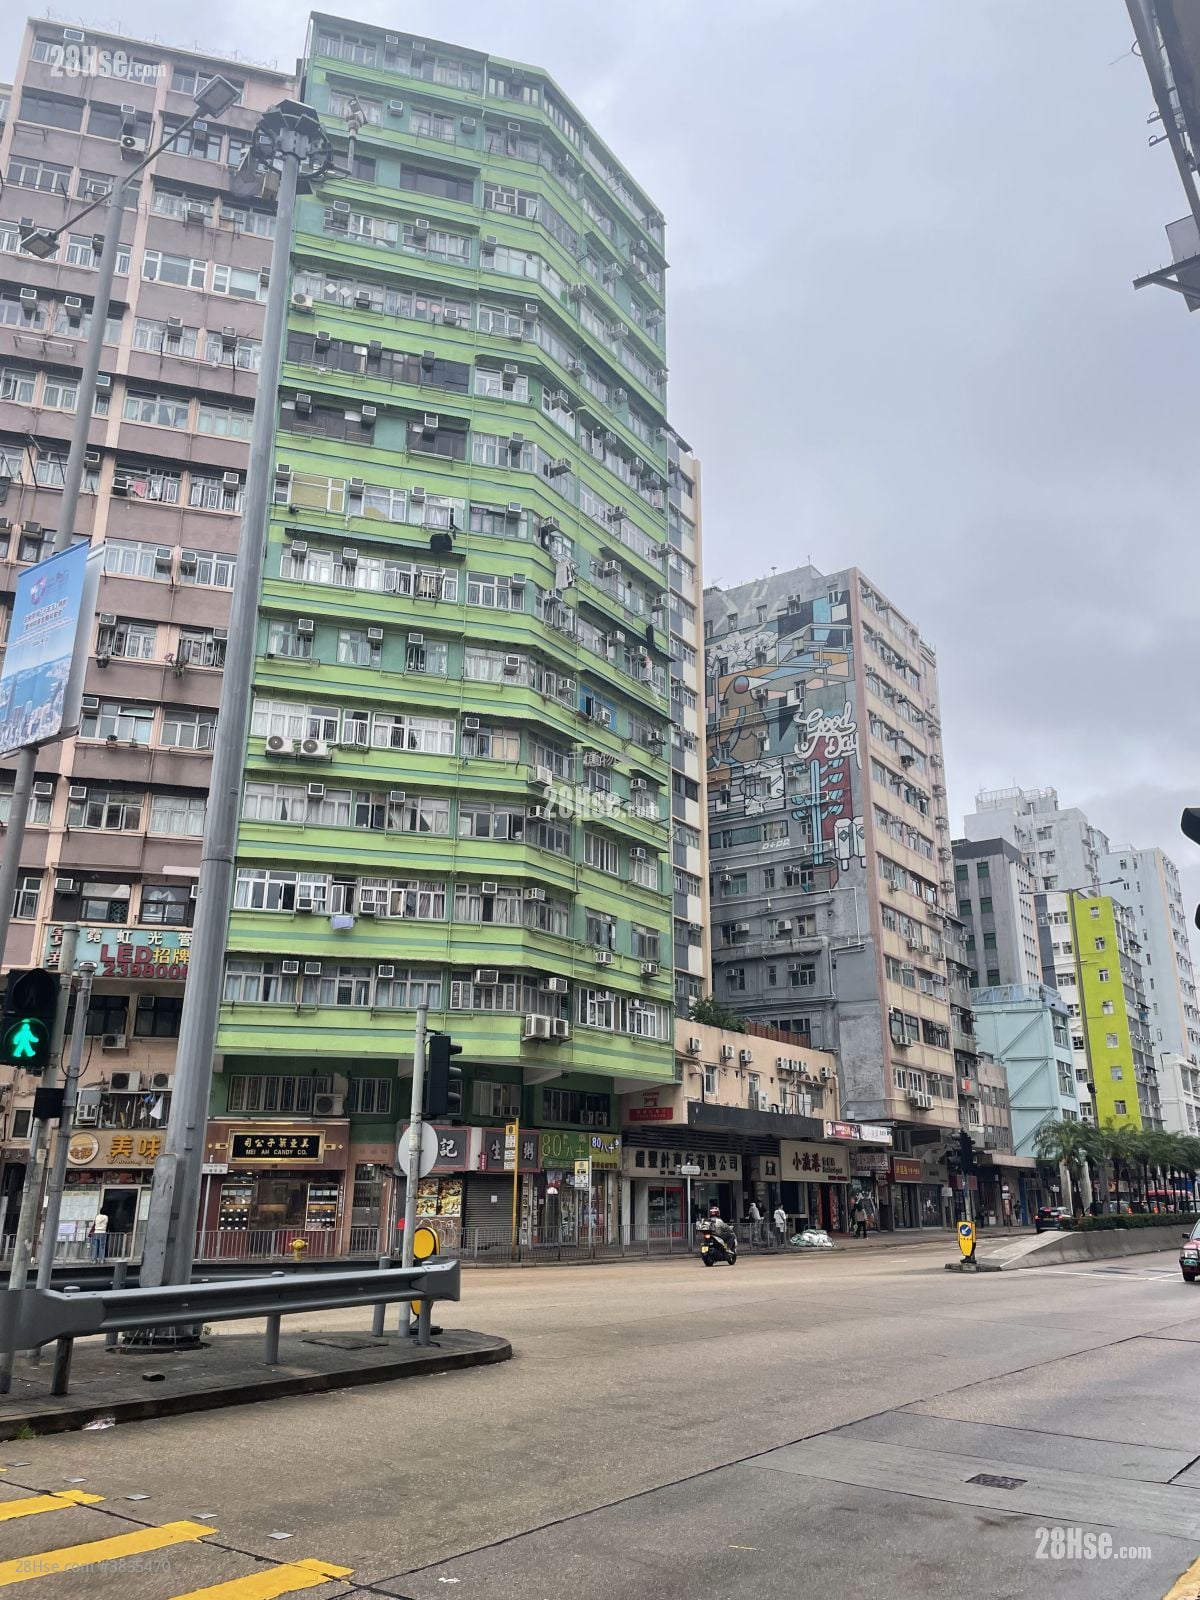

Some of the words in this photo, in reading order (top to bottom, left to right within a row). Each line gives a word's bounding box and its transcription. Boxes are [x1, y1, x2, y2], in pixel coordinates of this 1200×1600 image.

[793, 700, 857, 735] Good
[794, 729, 863, 770] Day
[110, 1135, 161, 1159] 美味
[440, 1137, 458, 1157] 記
